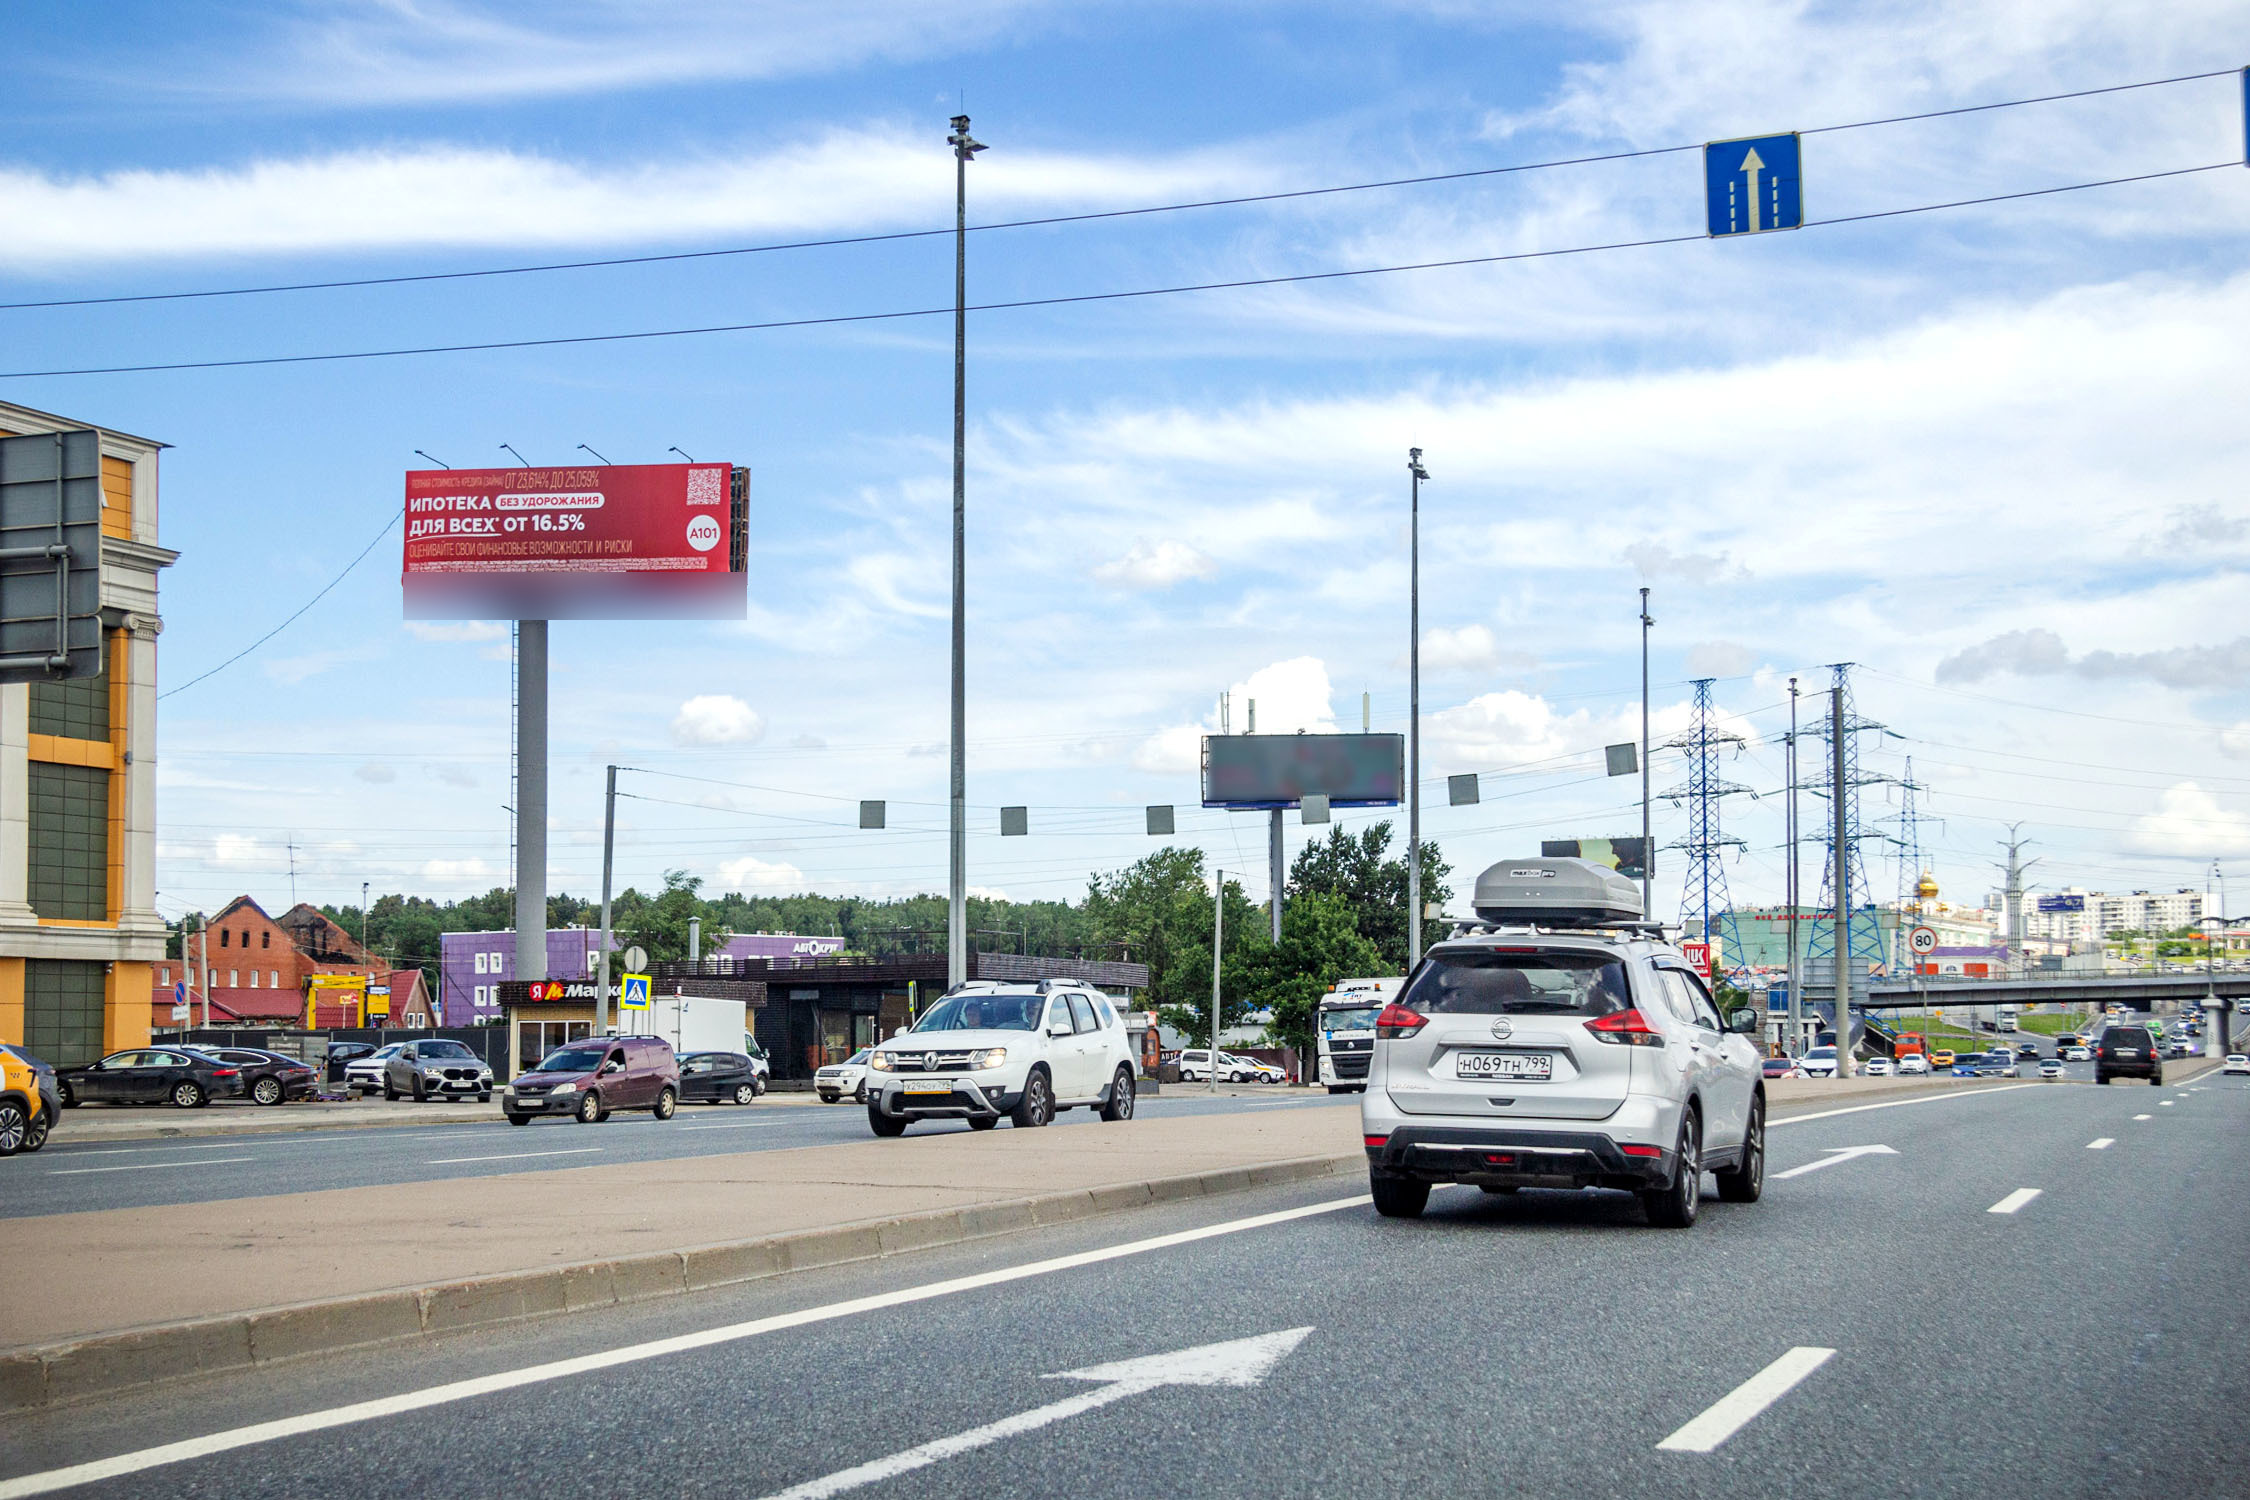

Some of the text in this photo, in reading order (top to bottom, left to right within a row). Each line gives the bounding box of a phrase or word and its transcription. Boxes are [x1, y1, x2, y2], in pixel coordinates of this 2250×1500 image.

[504, 472, 516, 489] ОТ
[549, 471, 564, 490] ДО
[410, 496, 600, 513] ИПОТЕКА БЕЗ УДОРОЖАНИЯ
[409, 519, 446, 537] ДЛЯ
[503, 517, 528, 532] ОТ
[531, 514, 586, 532] 16.5%
[409, 540, 633, 559] ОЦЕНИВАЙТЕ СВОИ ФИНАНСОВЫЕ ВОЗМОЖНОСТИ И РИСКИ
[1915, 935, 1931, 946] 80
[1462, 1056, 1546, 1072] Н069ТН 799
